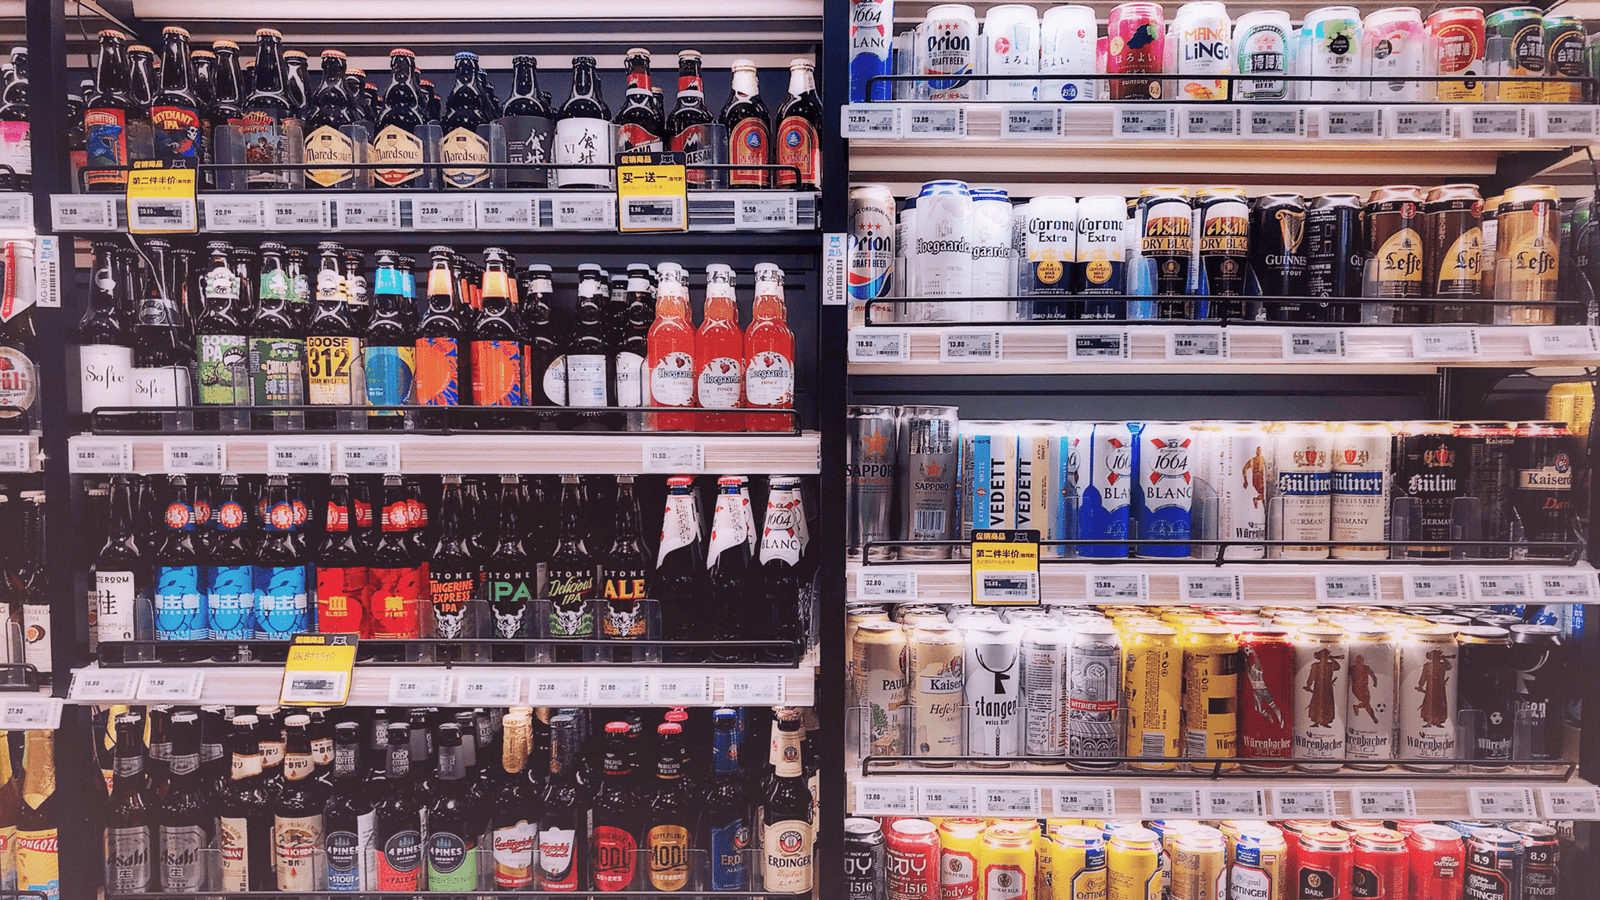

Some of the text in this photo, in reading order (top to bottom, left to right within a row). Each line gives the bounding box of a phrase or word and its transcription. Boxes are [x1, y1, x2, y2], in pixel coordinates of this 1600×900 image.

[853, 9, 882, 22] 1664
[928, 31, 970, 51] Orion
[932, 57, 964, 66] DRAFT BEER
[1115, 52, 1156, 63] ほろよい
[1062, 87, 1076, 96] お酒
[164, 118, 179, 130] IPA
[565, 143, 575, 154] VI
[307, 148, 351, 161] Maredsous
[132, 177, 176, 185] 第二件半价
[623, 171, 667, 183] 买一送一
[1029, 218, 1074, 234] Corona
[1079, 218, 1124, 234] Corona
[1036, 234, 1067, 242] Extra
[1087, 234, 1116, 242] Extra
[1143, 239, 1164, 249] DRY
[1201, 239, 1223, 249] DRY
[853, 260, 887, 268] DRAFT BEER
[1384, 251, 1422, 276] Leffe
[1516, 251, 1555, 276] Leffe
[40, 260, 48, 303] AG-09-31-1
[202, 336, 246, 346] GOOSE
[309, 338, 349, 347] GOOSE
[202, 347, 222, 362] IPA
[310, 349, 349, 377] 312
[86, 365, 125, 389] Sofie
[135, 379, 165, 398] Sofie
[1155, 455, 1188, 470] 1664
[914, 482, 948, 491] SAPPORO
[991, 458, 1005, 526] VEDETT
[1018, 458, 1032, 525] VEDETT
[767, 512, 792, 526] 1664
[762, 539, 798, 550] BLANC
[976, 549, 1019, 558] 第二件半价
[430, 580, 473, 594] TANGERINE
[489, 582, 532, 602] IPA
[549, 577, 592, 596] Delicious
[604, 580, 645, 599] ALE
[433, 592, 470, 604] EXPRESS
[562, 594, 581, 605] IPA
[1070, 702, 1097, 710] WITBIER
[1243, 736, 1291, 749] Würenbacher
[1295, 735, 1343, 751] Würenbacher
[1407, 736, 1455, 749] Würenbacher
[392, 751, 408, 760] CRISP
[334, 846, 359, 854] PINES
[389, 844, 421, 855] 4 PINES
[437, 847, 462, 855] PINES
[108, 849, 148, 866] Asahi
[768, 854, 812, 868] ERDINGER
[1474, 854, 1489, 865] 8.9
[1530, 852, 1547, 861] 8.9
[119, 869, 131, 878] 生
[171, 868, 182, 877] 生
[332, 875, 355, 883] STOUT
[849, 882, 873, 892] 1516
[904, 883, 928, 893] 1516
[941, 884, 973, 898] Cody's
[1304, 888, 1323, 896] DARK
